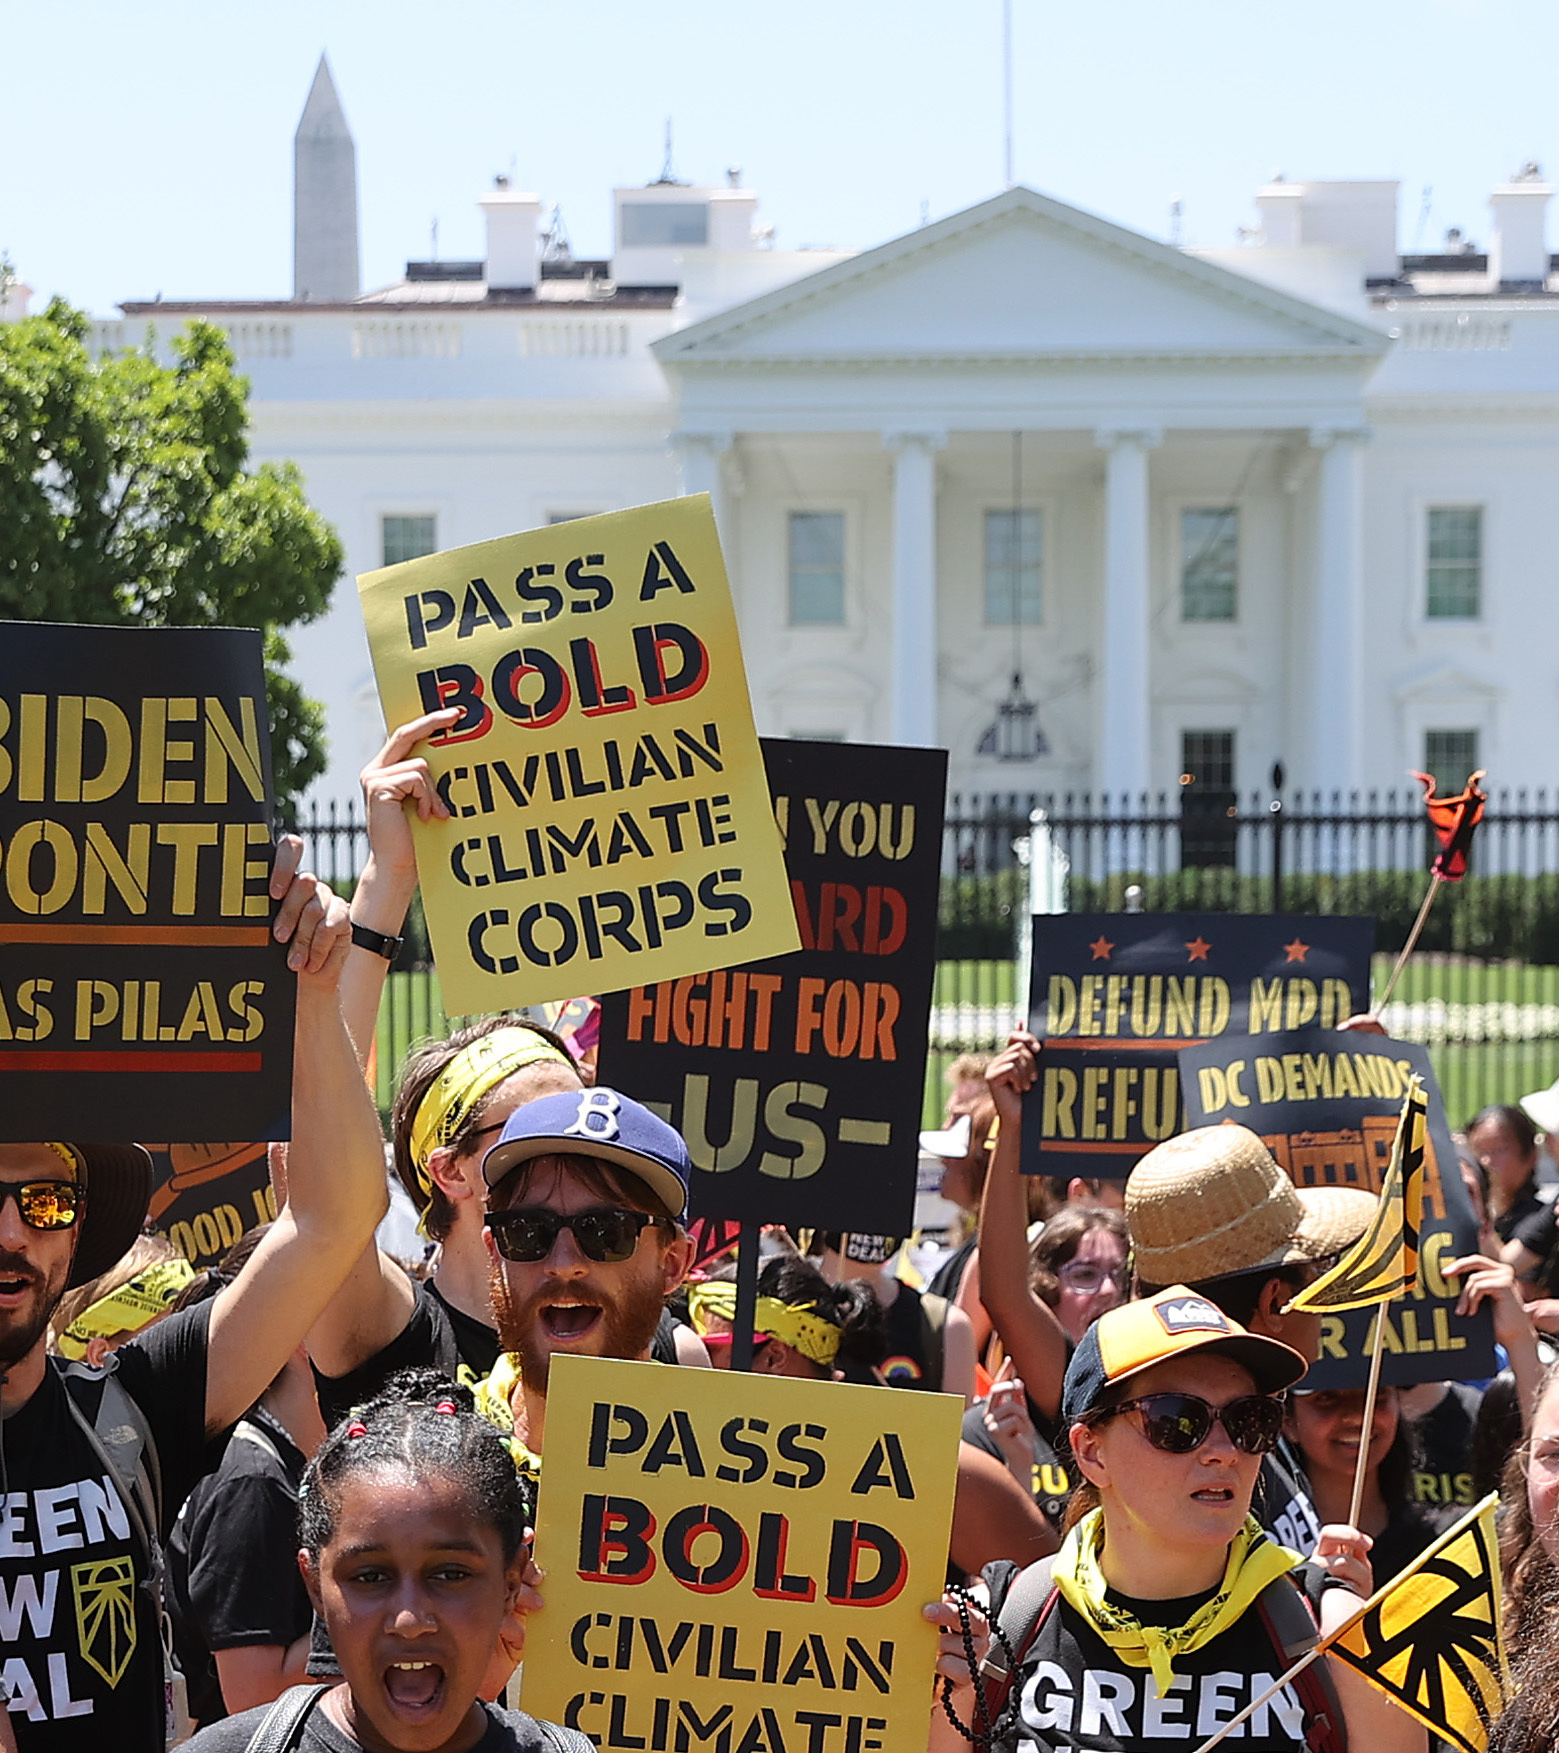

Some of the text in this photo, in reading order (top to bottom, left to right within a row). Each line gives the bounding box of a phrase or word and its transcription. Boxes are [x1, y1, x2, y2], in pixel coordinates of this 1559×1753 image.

[404, 541, 696, 650] PASS A
[417, 621, 710, 749] BOLD
[436, 722, 725, 819] CIVILIAN
[450, 794, 737, 887] CLIMATE
[804, 798, 916, 861] YOU
[468, 868, 752, 976] CORPS
[75, 979, 265, 1044] PILAS
[627, 970, 901, 1061] FIGHT FOR
[1046, 973, 1353, 1038] DEFUND MPD
[564, 1087, 621, 1139] B
[1042, 1066, 1188, 1141] REFU
[1198, 1052, 1413, 1115] DC DEMANDS
[1361, 1307, 1468, 1358] ALL
[587, 1402, 915, 1501] PASS A
[576, 1492, 910, 1609] BOLD
[569, 1611, 894, 1695] CIVILIAN
[1020, 1660, 1306, 1741] GREEN
